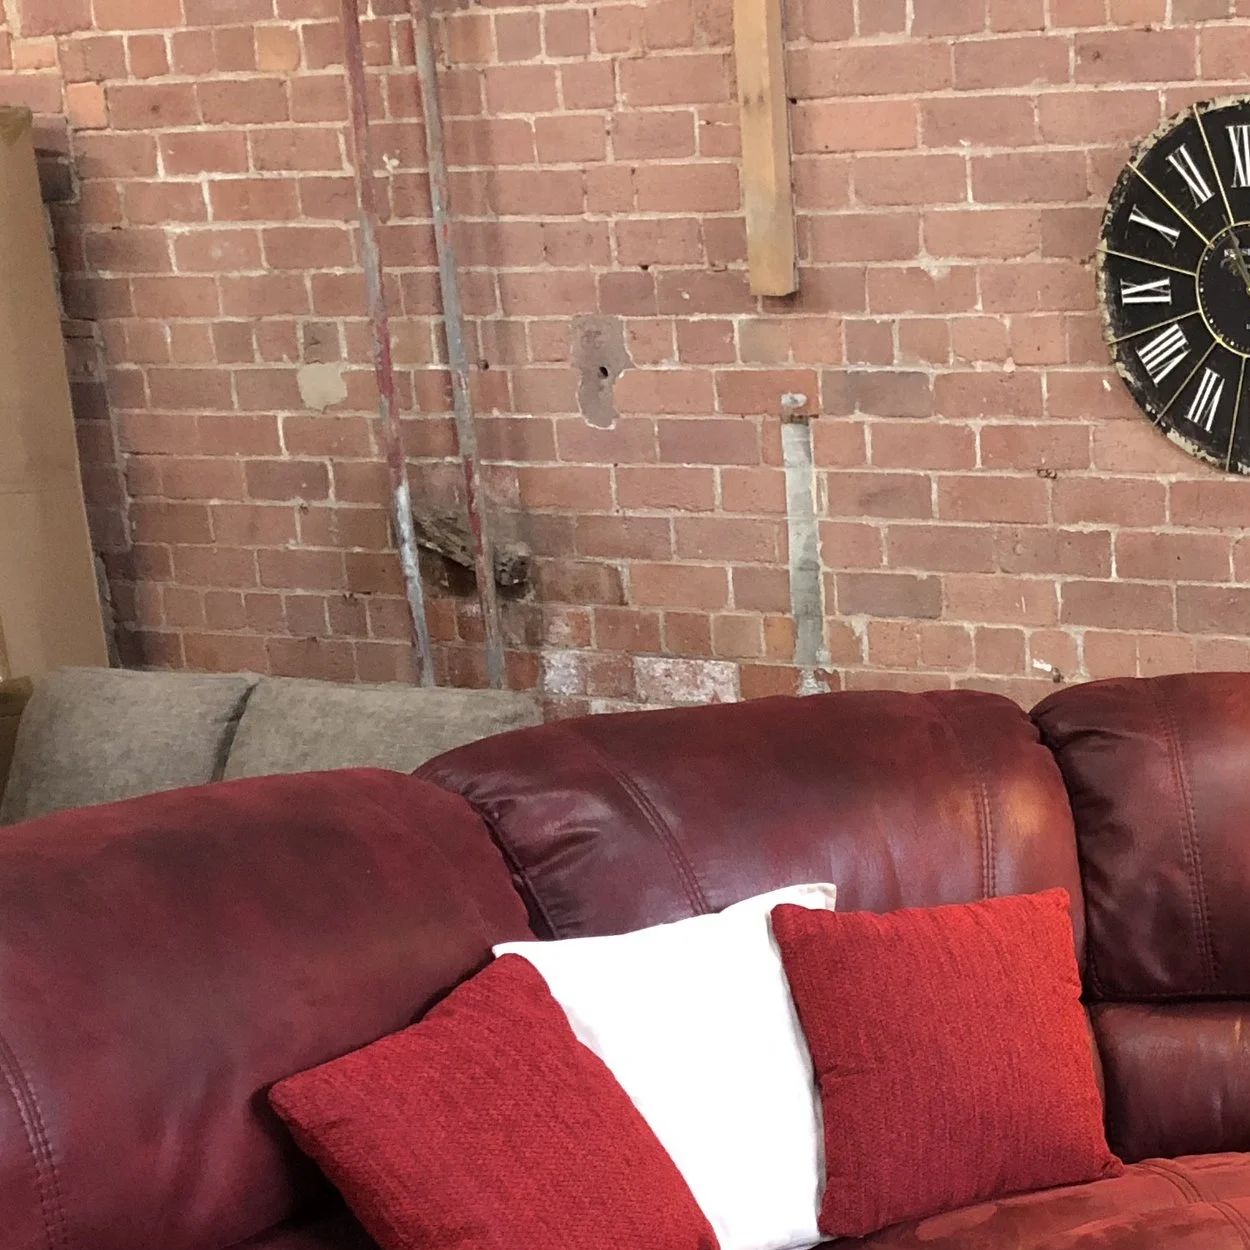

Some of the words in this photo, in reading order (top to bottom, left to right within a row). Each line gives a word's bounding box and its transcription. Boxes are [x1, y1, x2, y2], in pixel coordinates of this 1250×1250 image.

[1165, 143, 1216, 210] XI
[1128, 203, 1182, 247] X
[1120, 277, 1172, 304] IX
[1134, 322, 1192, 387] VIII
[1183, 365, 1225, 433] VII
